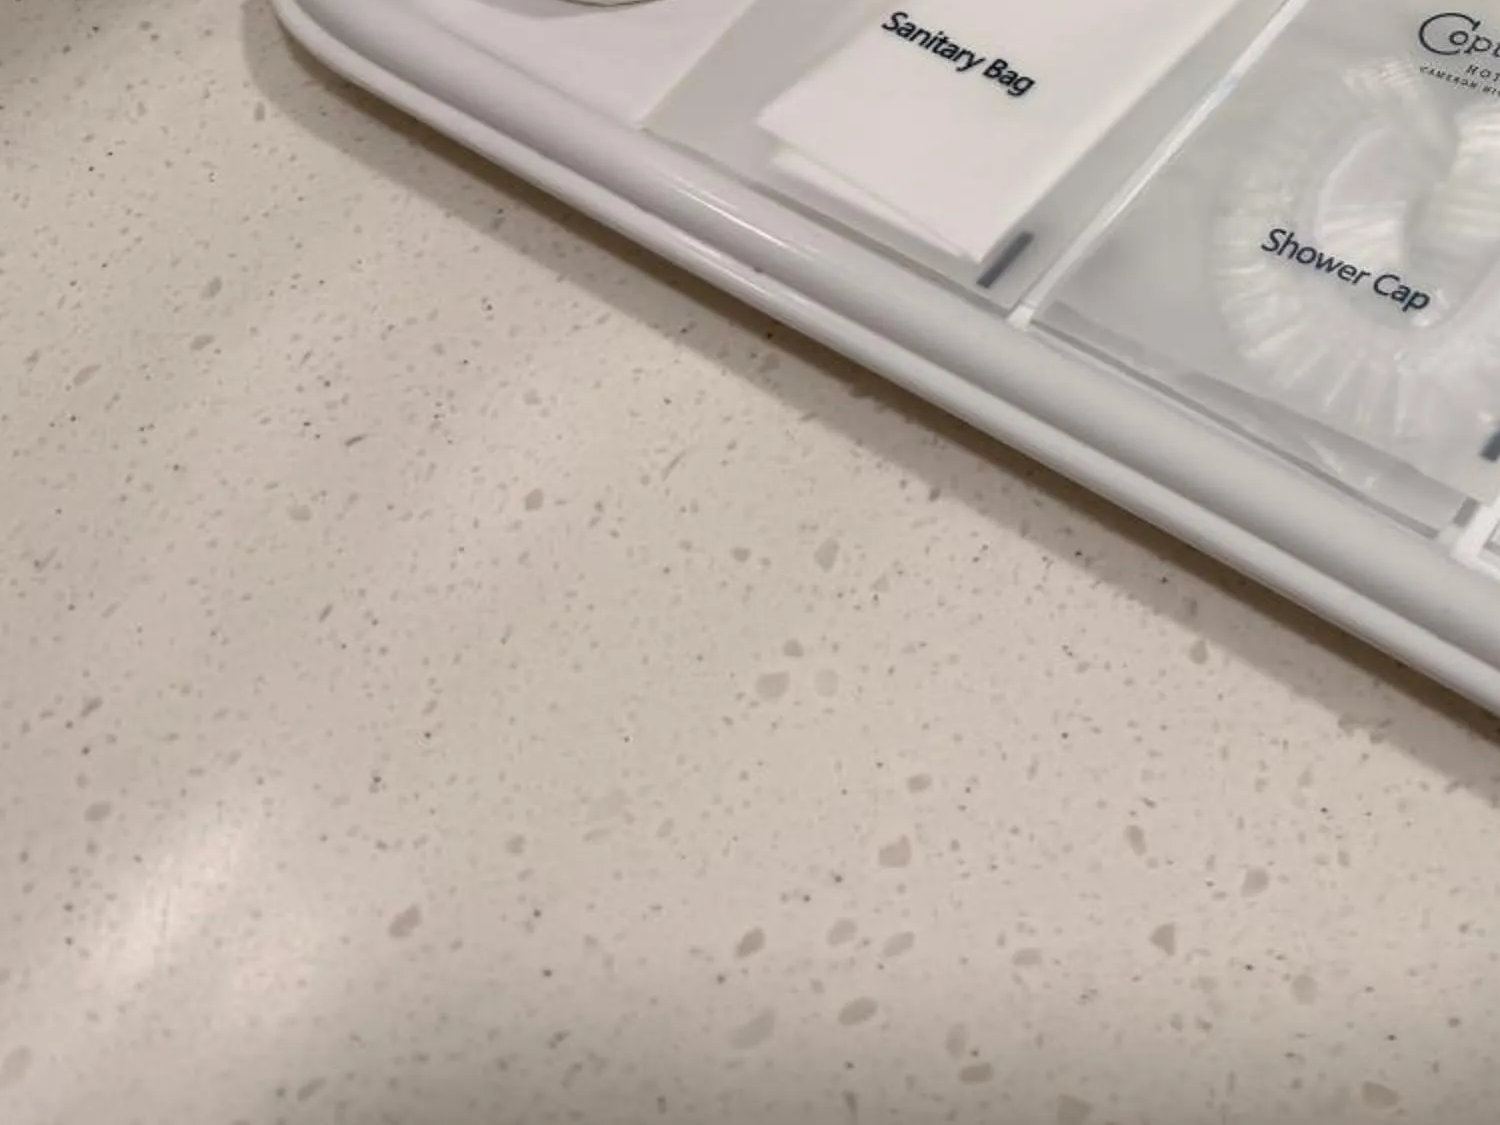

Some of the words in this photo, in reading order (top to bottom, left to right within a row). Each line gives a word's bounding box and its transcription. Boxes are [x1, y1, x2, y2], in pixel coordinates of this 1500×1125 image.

[881, 11, 987, 72] Sanitary
[982, 58, 1036, 97] Bag
[1260, 228, 1371, 286] Shower
[1372, 273, 1431, 313] Cap
